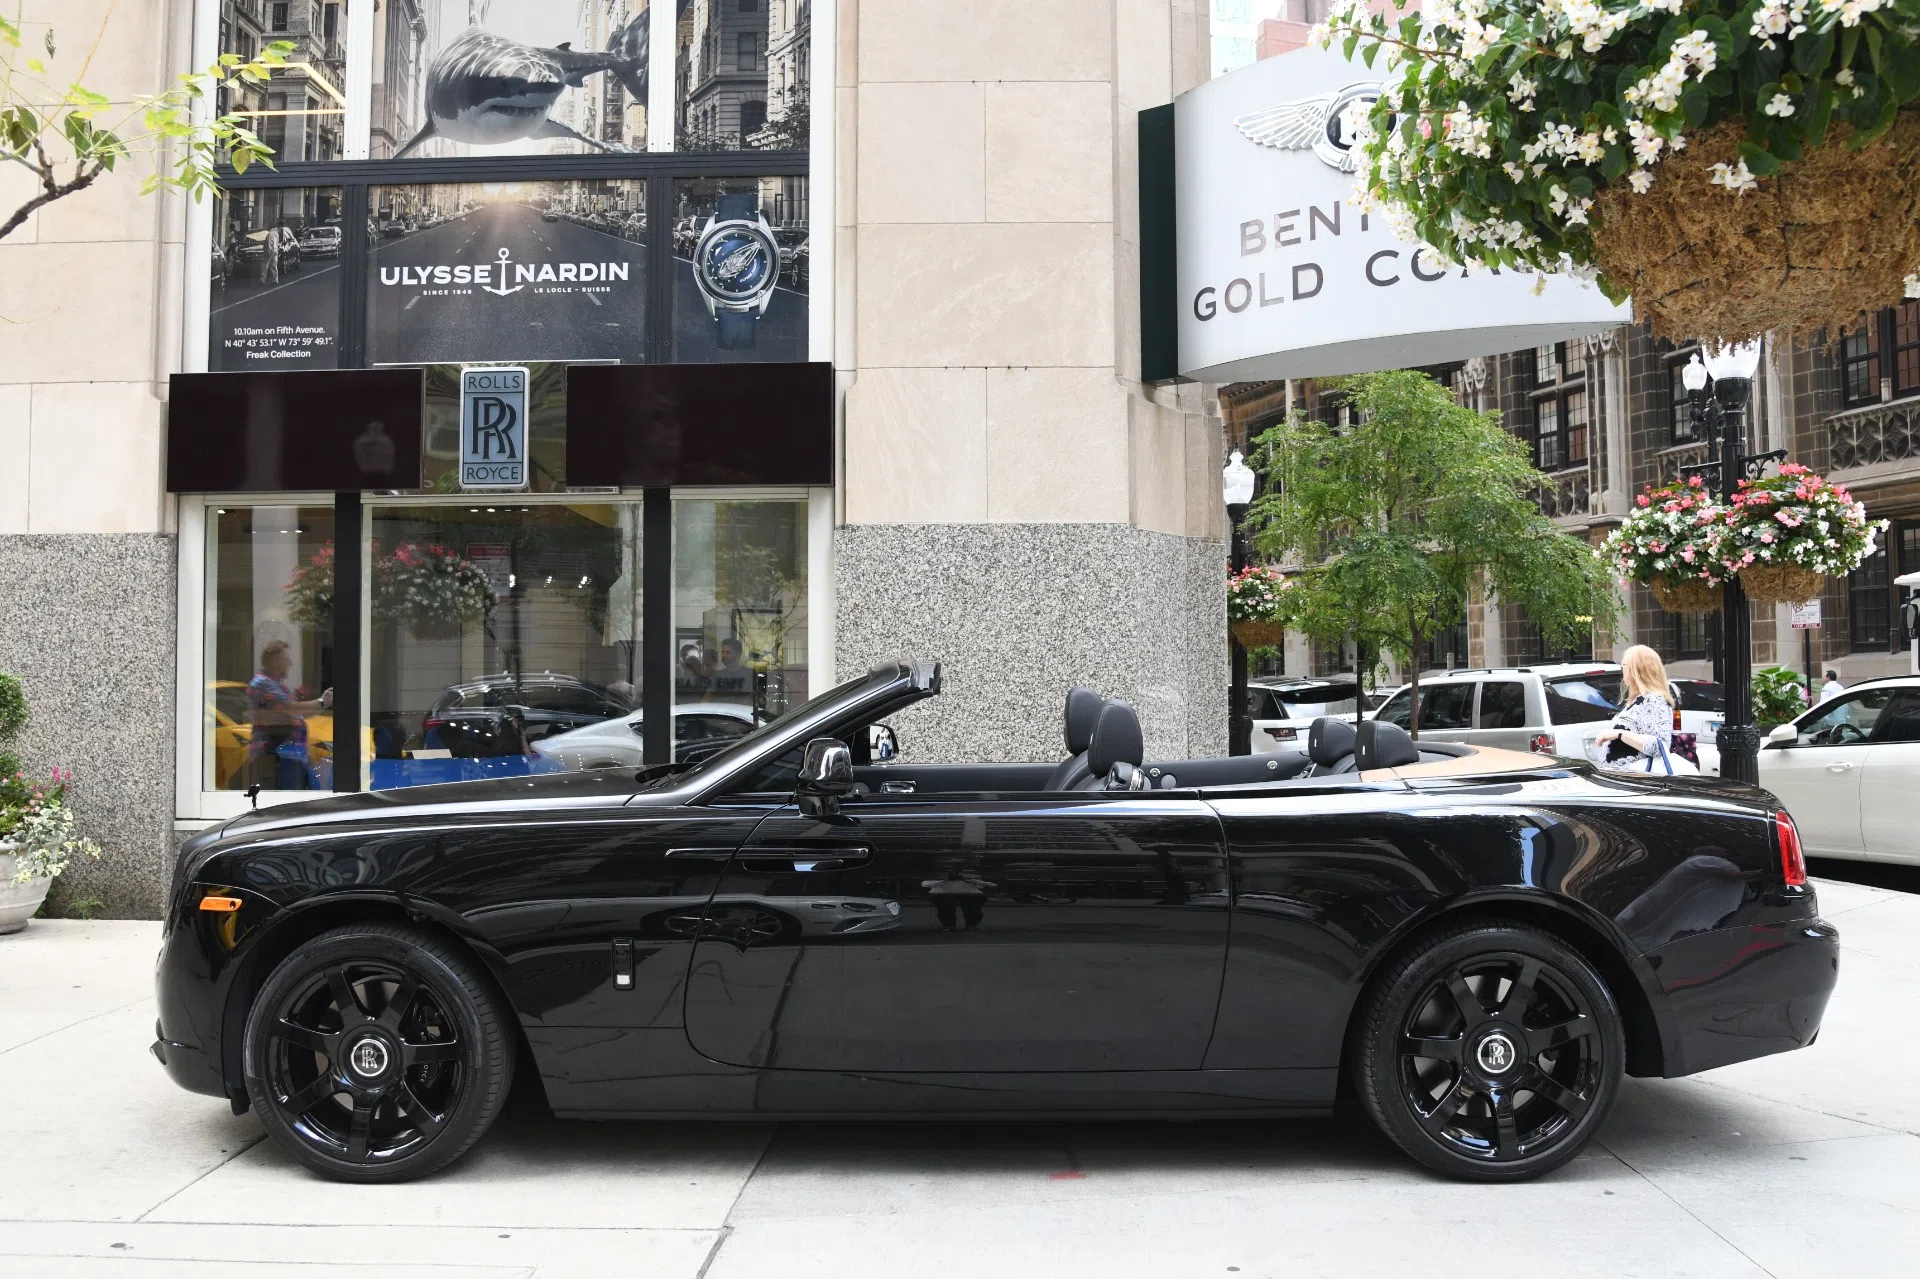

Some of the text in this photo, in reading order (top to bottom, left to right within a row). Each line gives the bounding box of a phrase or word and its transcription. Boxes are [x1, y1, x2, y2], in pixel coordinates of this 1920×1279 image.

[380, 262, 629, 286] ULYSSE NARDIN
[1193, 262, 1324, 322] GOLD
[233, 327, 264, 336] 10.10am
[276, 326, 294, 335] Fifth
[224, 340, 232, 348] N
[278, 338, 287, 346] W
[246, 350, 311, 359] Freak Collection
[468, 375, 521, 389] ROLLS
[471, 396, 517, 460] RR
[466, 466, 519, 480] ROYCE
